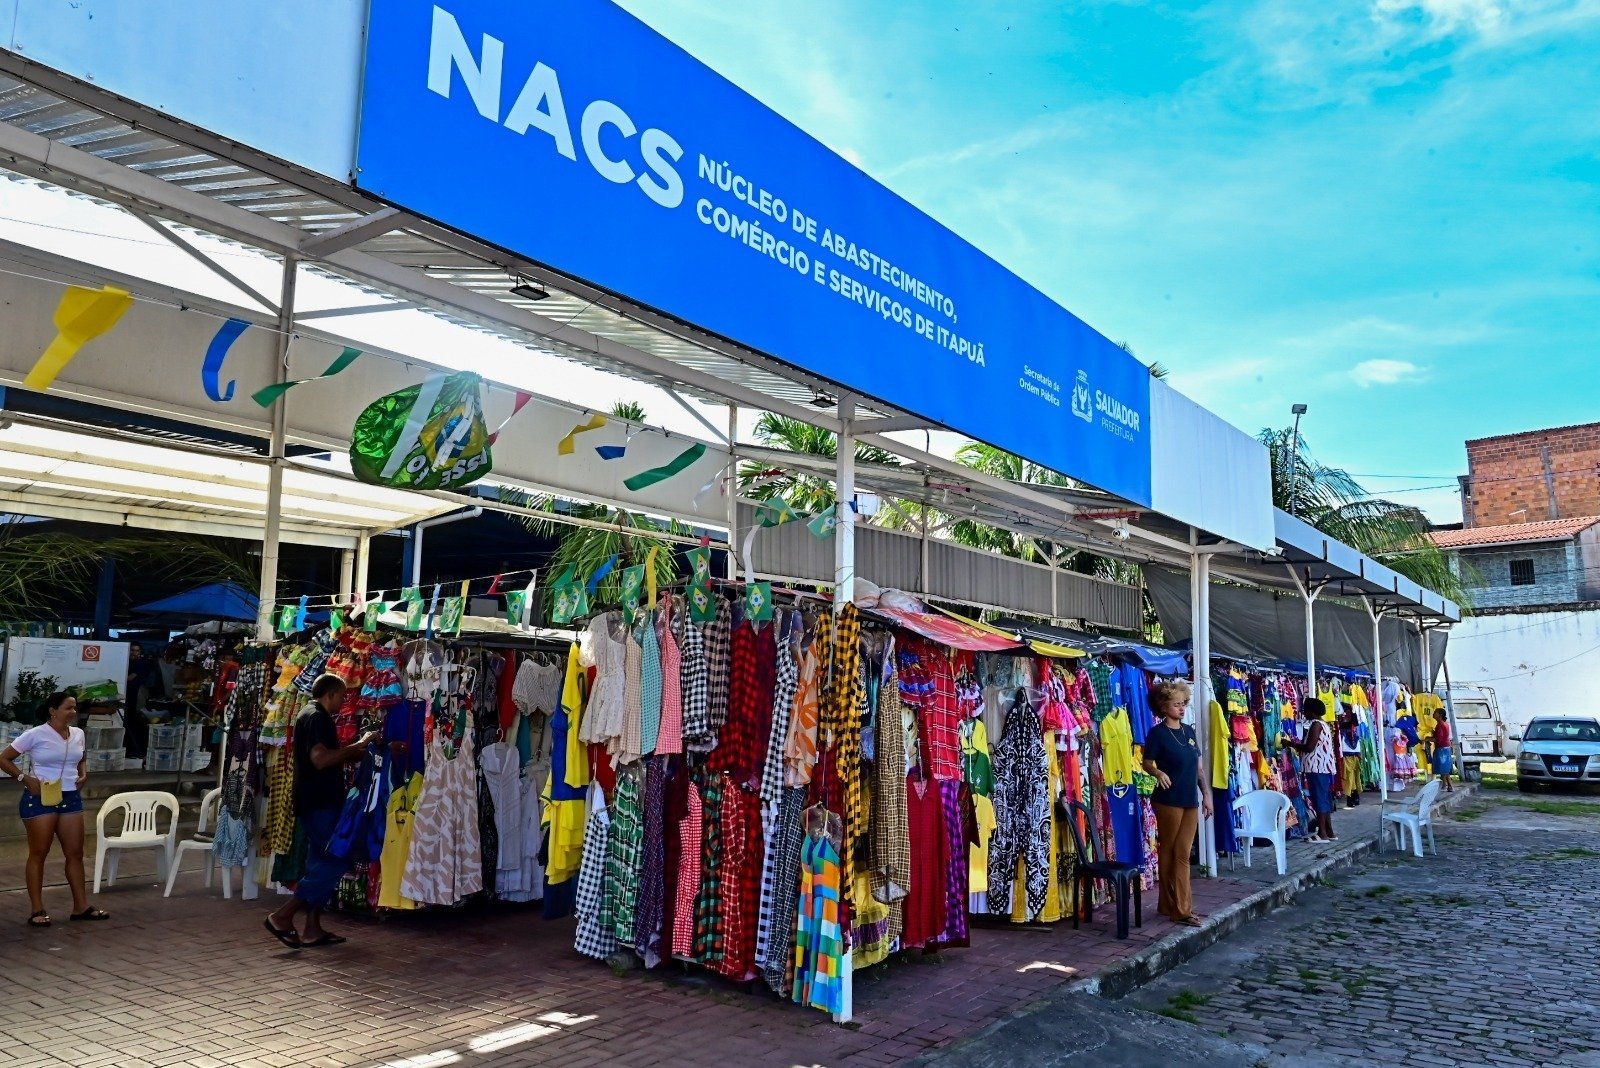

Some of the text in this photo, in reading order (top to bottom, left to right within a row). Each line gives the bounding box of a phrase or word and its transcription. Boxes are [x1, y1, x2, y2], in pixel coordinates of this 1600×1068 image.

[427, 4, 684, 209] NACS
[698, 153, 958, 324] NÚCLEO DE ABASTECIMENTO,
[696, 198, 986, 367] COMÉRCIO E SERVIÇOS DE ITAPUÃ
[1019, 377, 1060, 407] Ordem Pública
[1024, 364, 1060, 393] Secretaria de
[1095, 389, 1140, 432] SALVADOR
[1101, 417, 1134, 443] PREFEITURA
